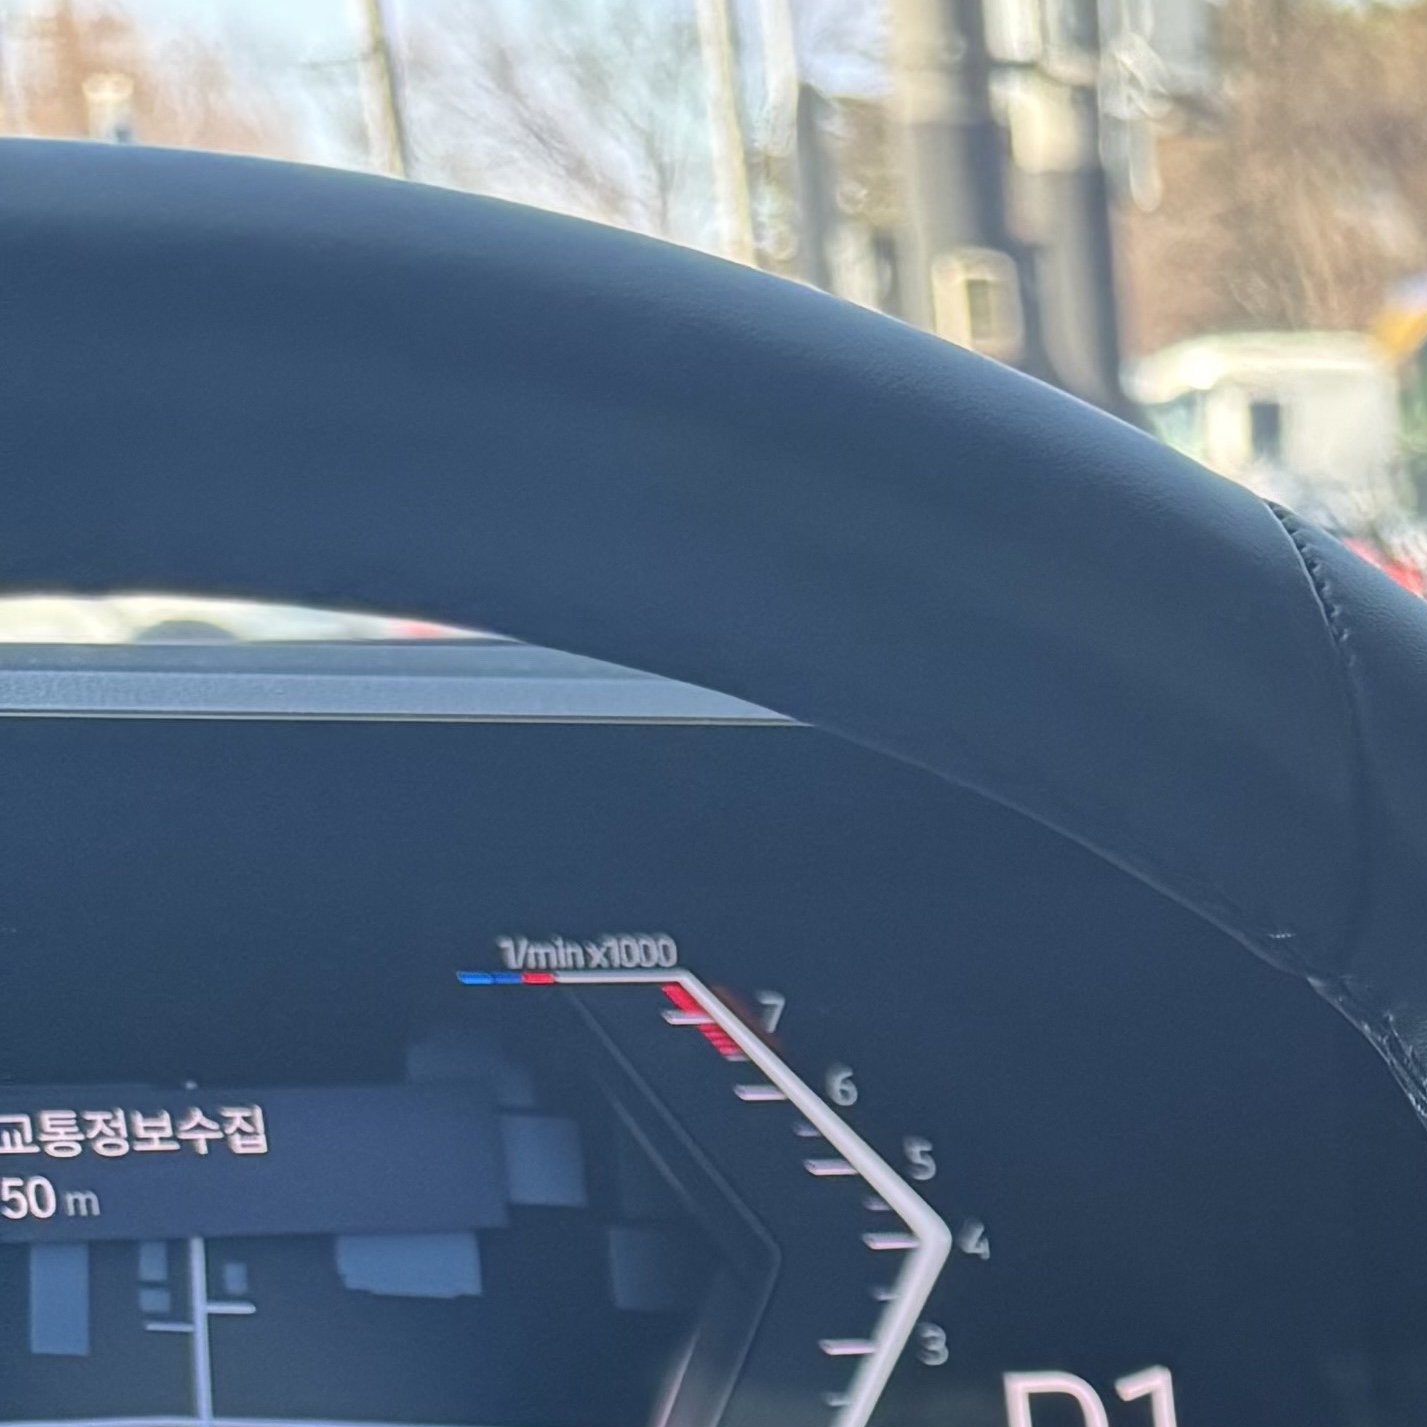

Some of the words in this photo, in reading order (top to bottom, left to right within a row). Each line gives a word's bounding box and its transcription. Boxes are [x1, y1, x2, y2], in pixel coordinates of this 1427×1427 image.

[757, 991, 785, 1033] 7
[826, 1063, 858, 1106] 6
[0, 1103, 268, 1158] 교통정보수집
[903, 1136, 936, 1180] 5
[956, 1219, 990, 1259] 4
[915, 1322, 948, 1365] 3
